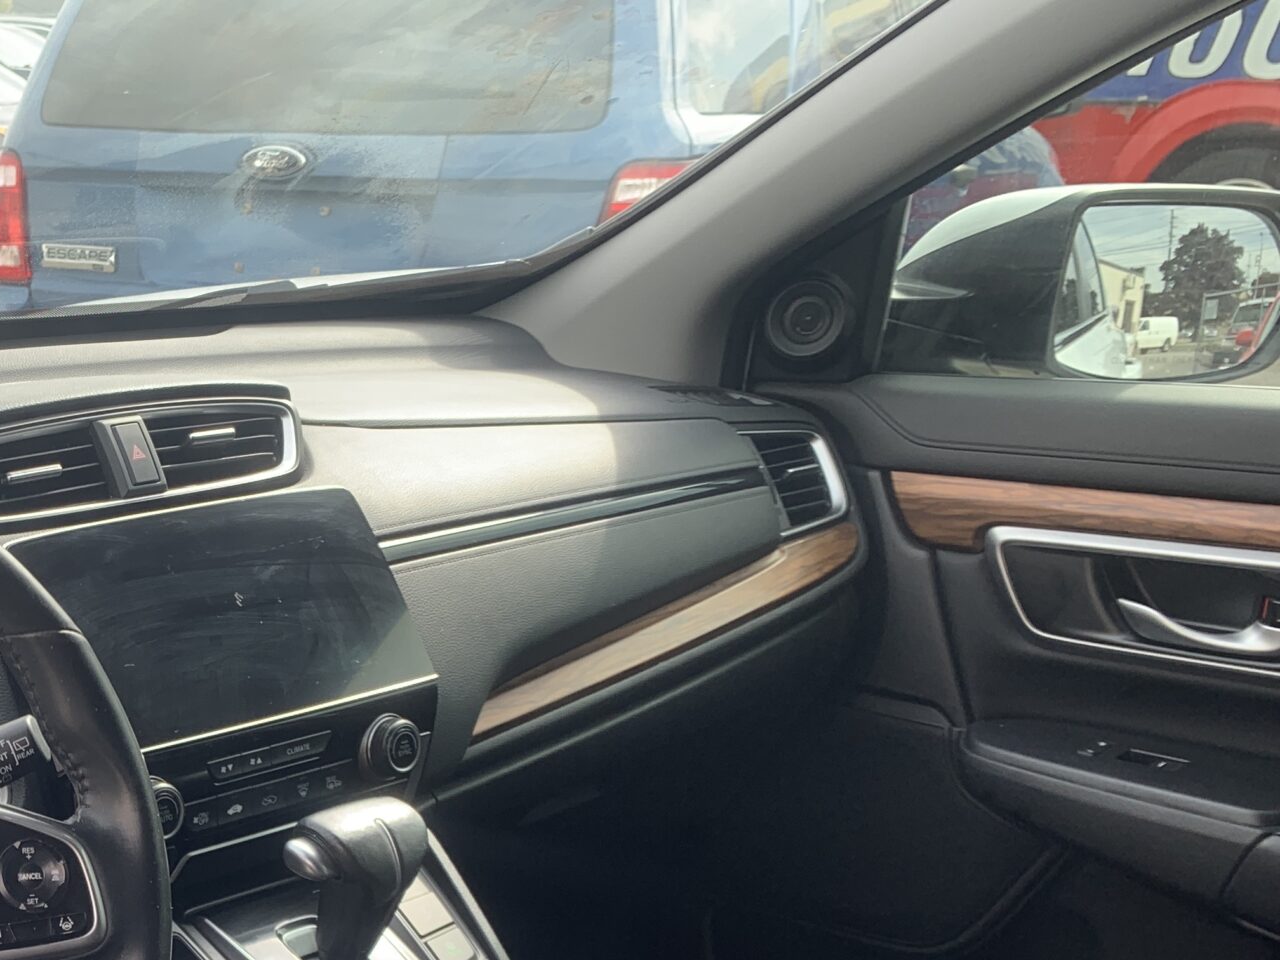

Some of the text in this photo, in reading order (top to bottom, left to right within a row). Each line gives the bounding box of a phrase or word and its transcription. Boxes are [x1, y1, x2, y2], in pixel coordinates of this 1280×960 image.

[47, 248, 109, 262] ESCAPE
[17, 749, 35, 760] REAR
[0, 765, 12, 775] ON
[26, 897, 39, 905] SET
